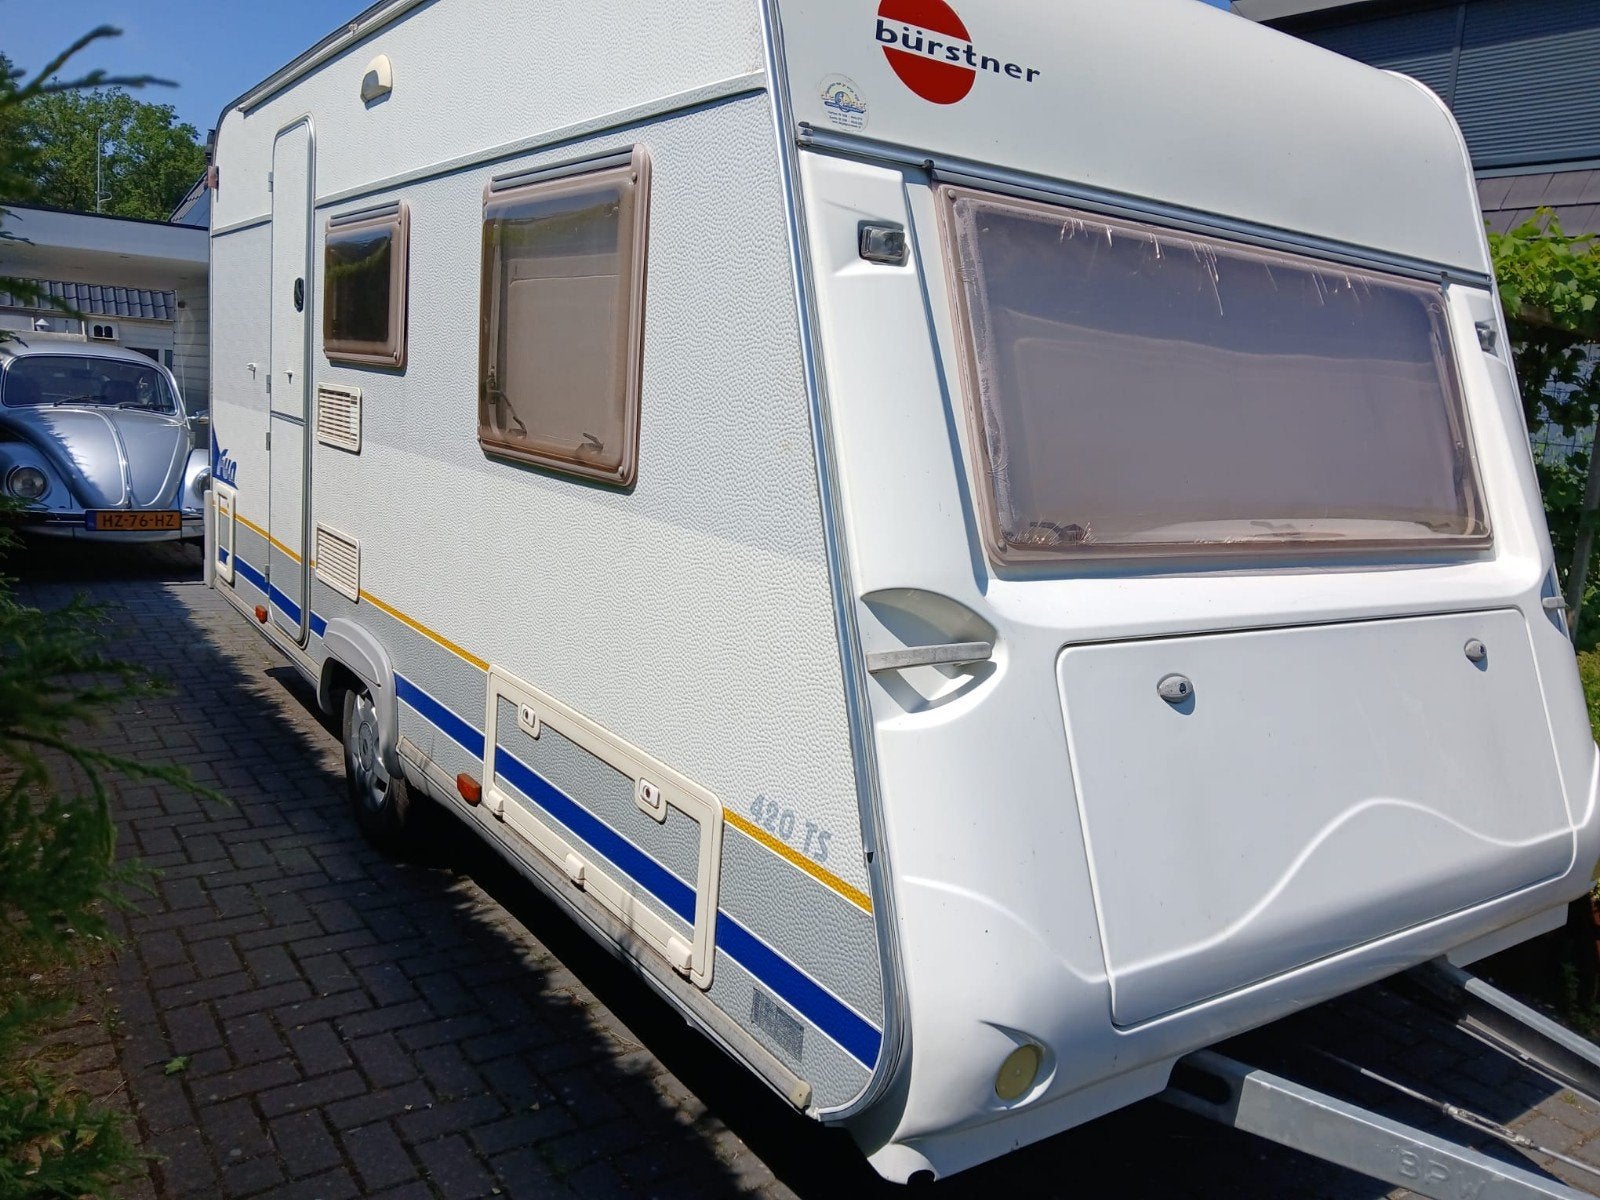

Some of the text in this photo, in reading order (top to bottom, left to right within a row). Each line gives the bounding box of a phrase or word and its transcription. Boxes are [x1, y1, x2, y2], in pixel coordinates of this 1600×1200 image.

[875, 19, 1040, 82] bürstner
[102, 514, 174, 527] HZ-76-HZ
[750, 794, 832, 862] 420 TS
